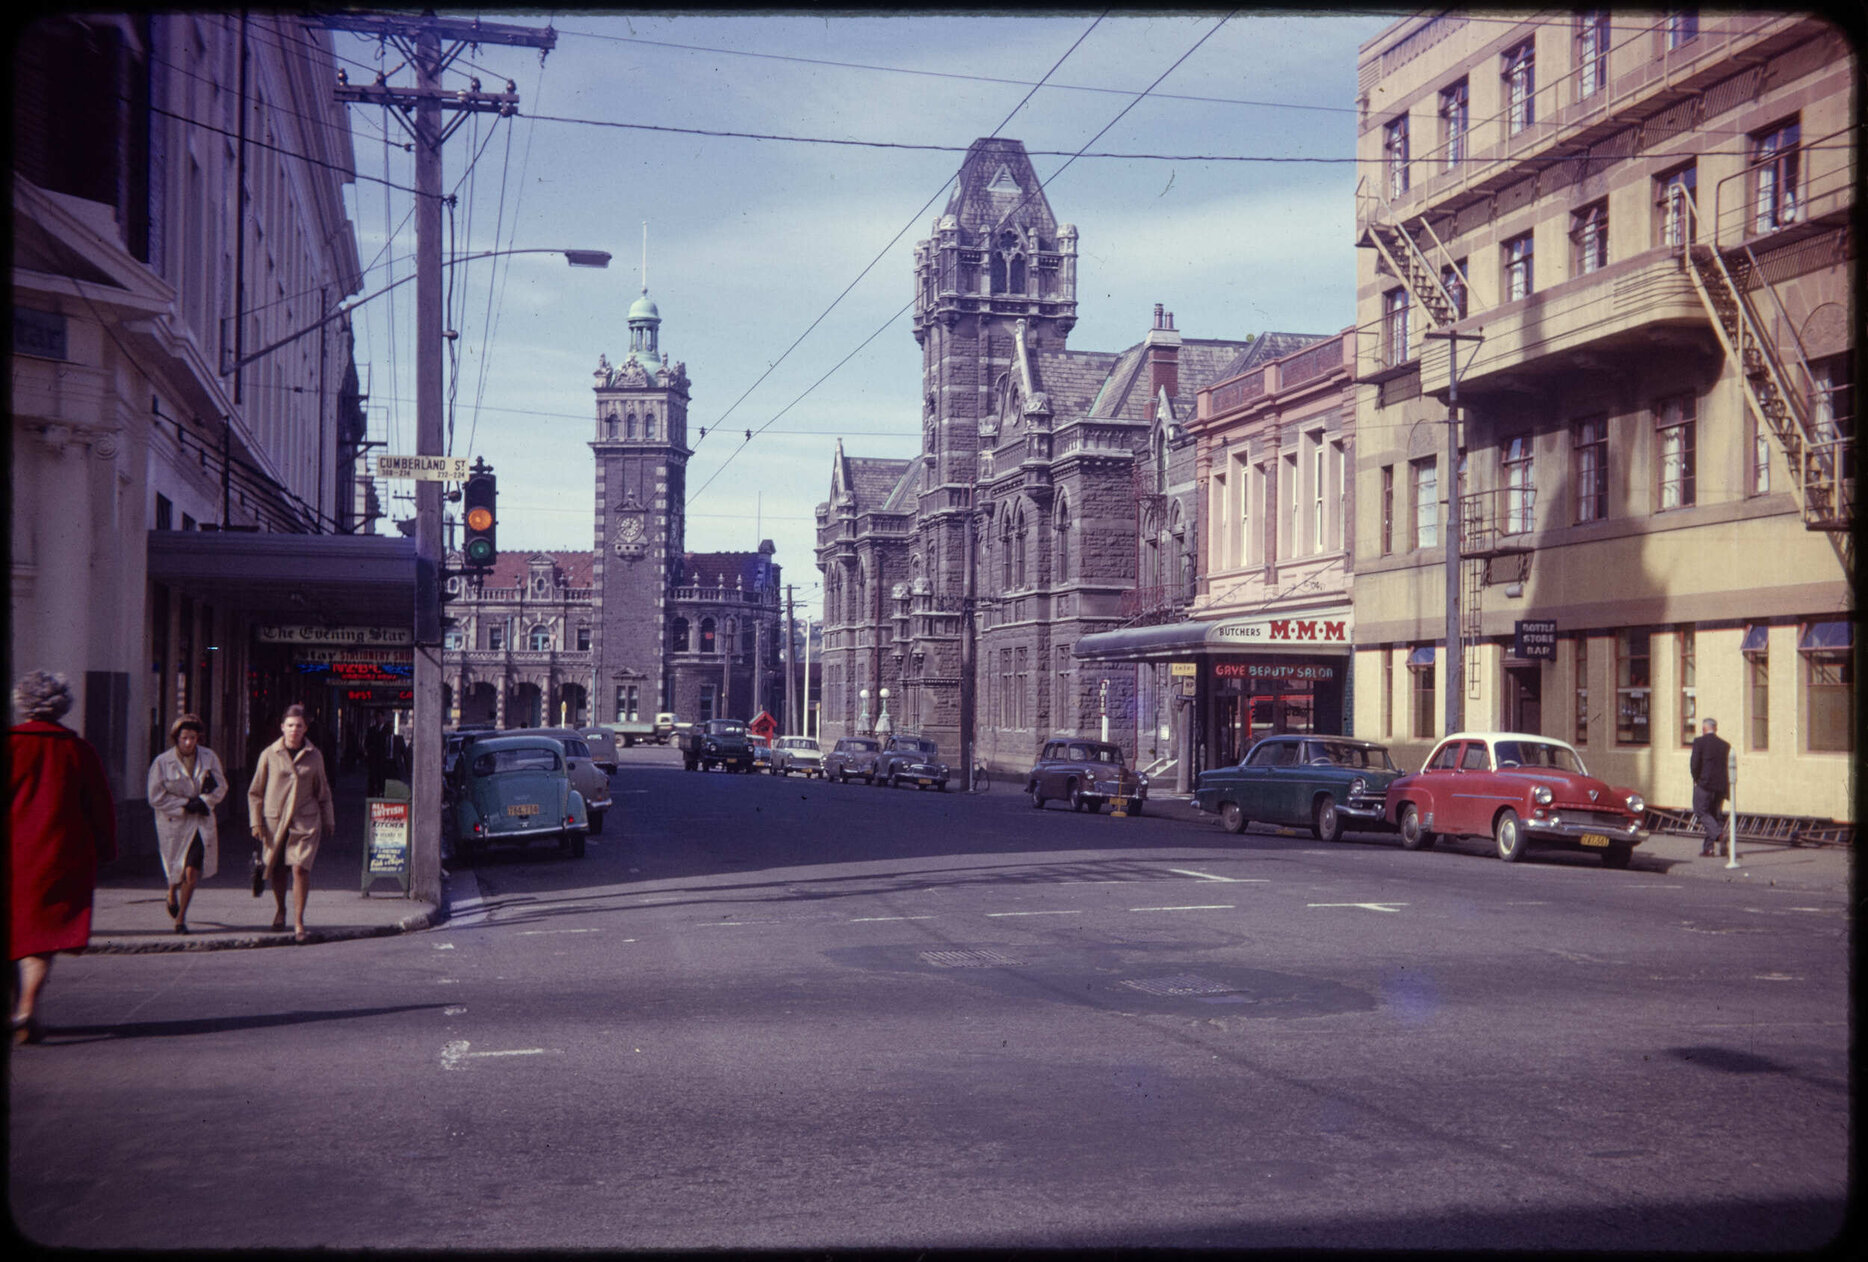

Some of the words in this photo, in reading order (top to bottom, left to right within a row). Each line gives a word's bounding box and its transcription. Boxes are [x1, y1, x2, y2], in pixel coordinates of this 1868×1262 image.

[379, 457, 446, 470] CUMBERLAND
[1219, 627, 1261, 637] BUTCHERS
[1522, 623, 1555, 633] BOTTLE
[262, 626, 295, 640] The
[299, 626, 366, 643] Evening
[368, 626, 407, 641] Star
[1522, 634, 1555, 643] STORE
[1526, 646, 1551, 655] BAR
[1215, 664, 1245, 676] GAYE
[1249, 665, 1295, 677] BEAUTY
[1296, 666, 1334, 678] SALON
[371, 806, 404, 817] BRITISH
